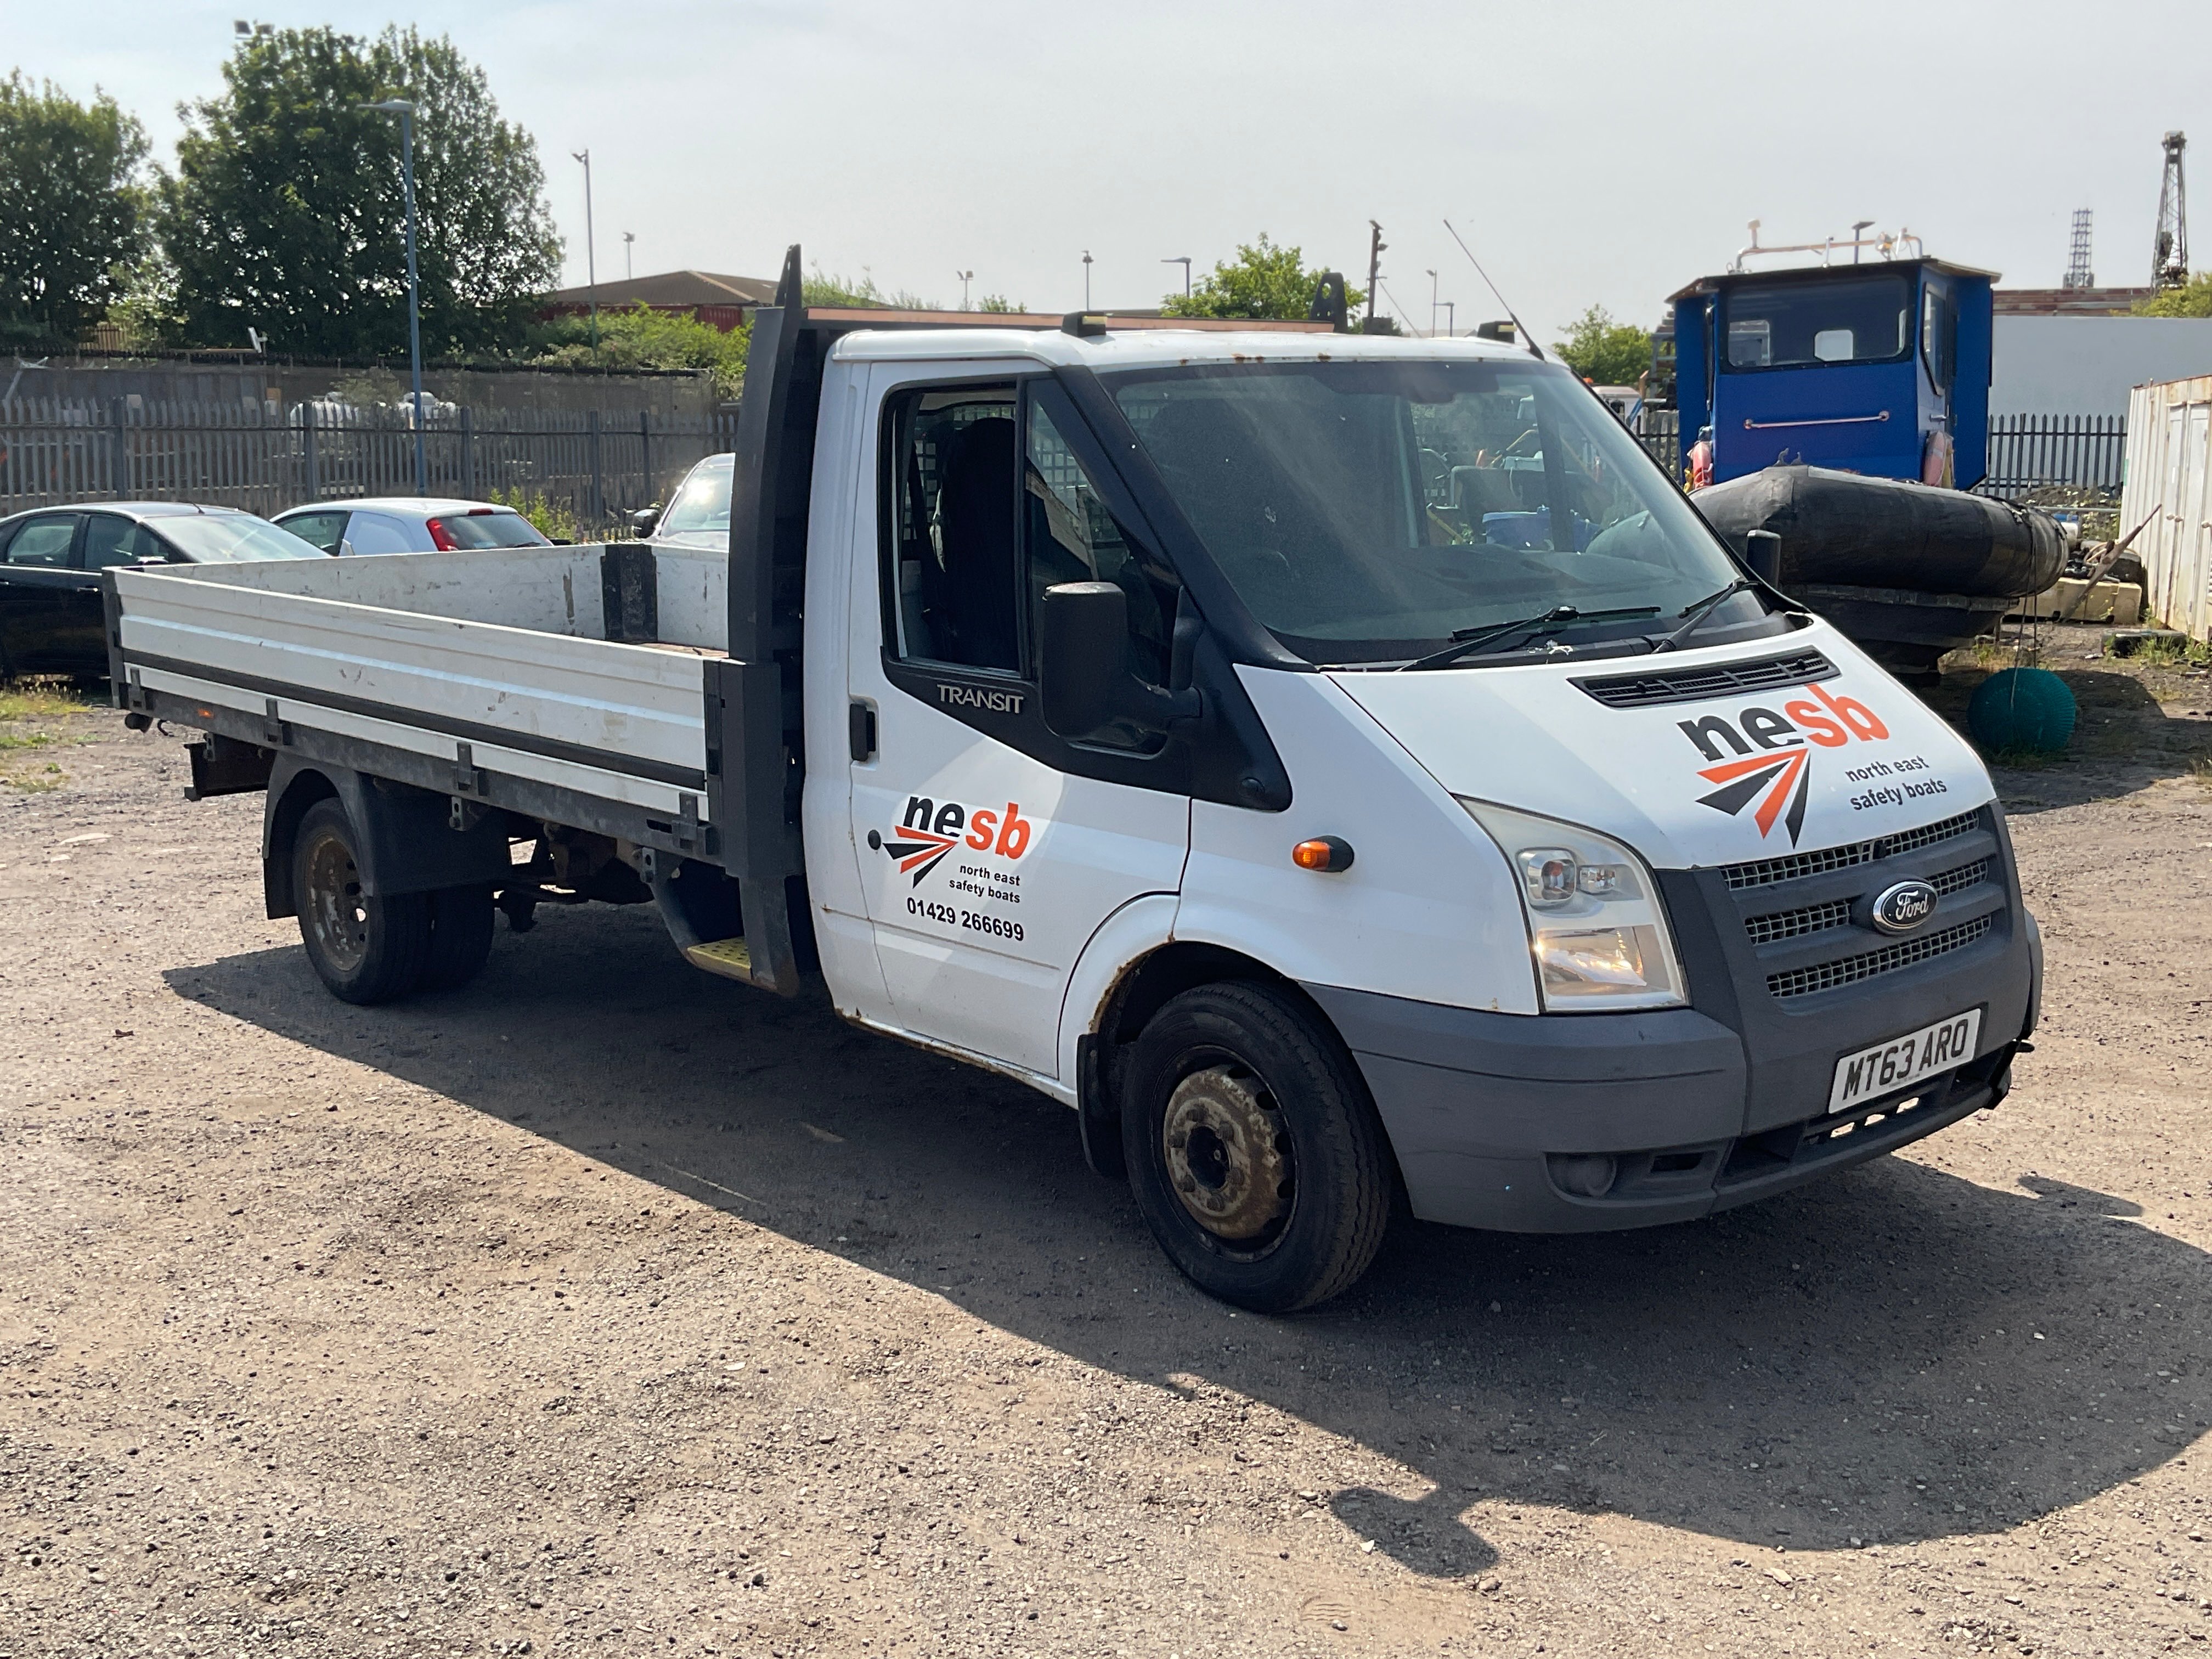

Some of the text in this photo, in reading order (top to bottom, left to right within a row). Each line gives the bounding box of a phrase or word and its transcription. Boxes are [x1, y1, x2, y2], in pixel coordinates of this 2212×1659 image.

[936, 684, 1024, 713] TRANSIT
[1676, 684, 1889, 761] nesb
[1846, 755, 1929, 782] north east
[1850, 778, 1947, 811] safety boats
[903, 797, 1031, 859] nesb
[949, 878, 1020, 903] safety boats
[960, 865, 1020, 885] north east
[907, 897, 1024, 941] 01429 266699
[1895, 890, 1929, 919] Ford
[1843, 1019, 1968, 1100] MT63 ARO
